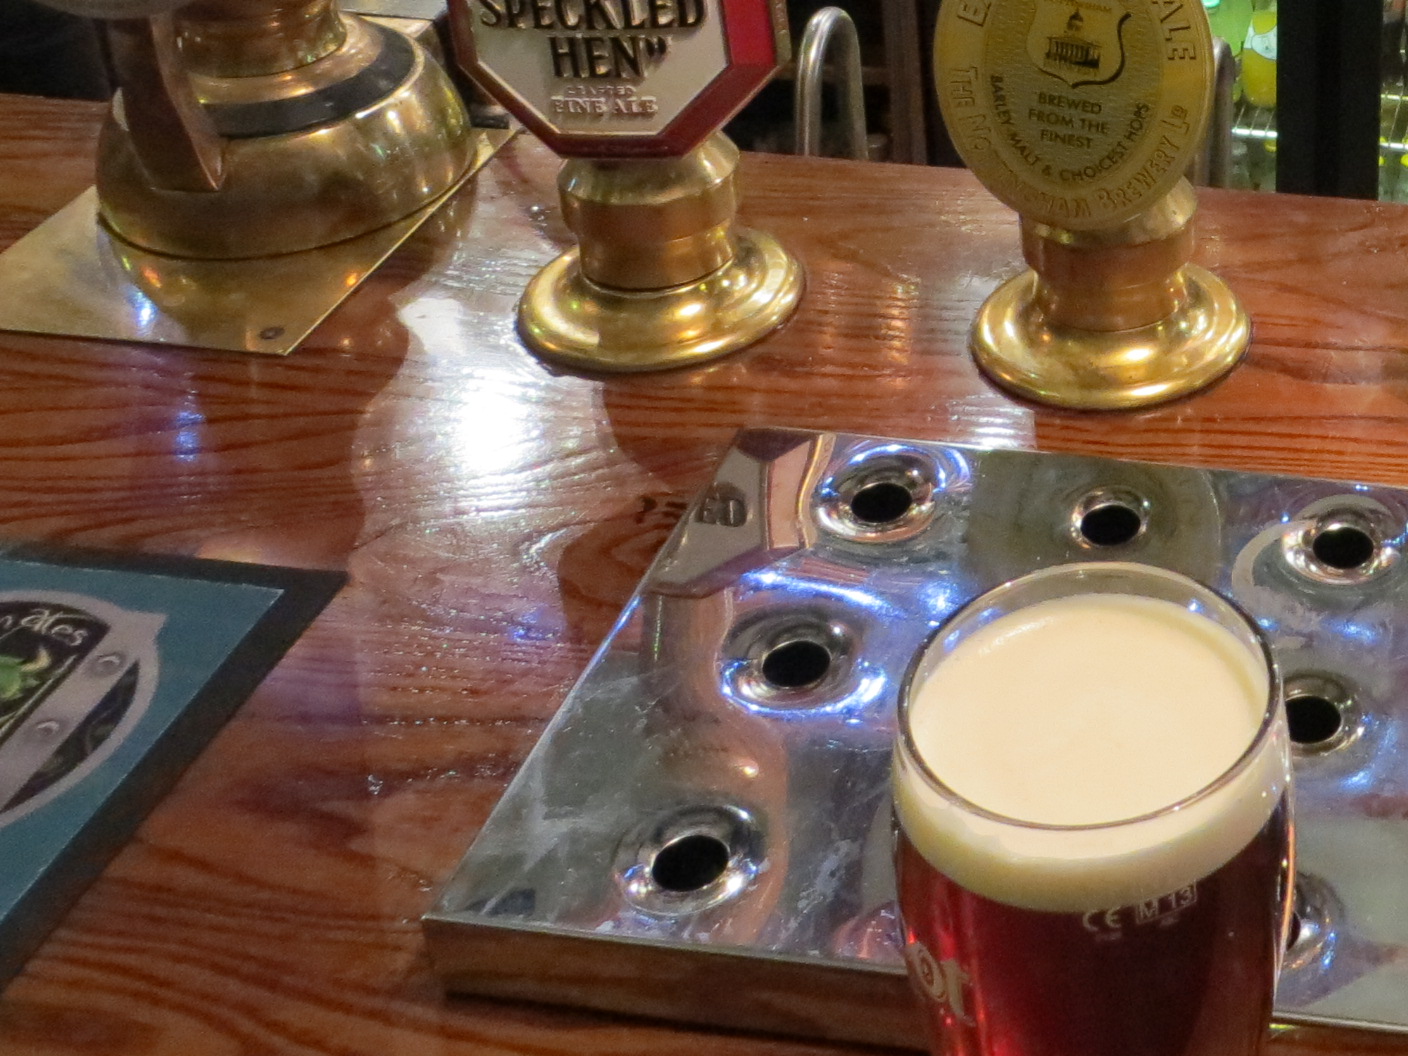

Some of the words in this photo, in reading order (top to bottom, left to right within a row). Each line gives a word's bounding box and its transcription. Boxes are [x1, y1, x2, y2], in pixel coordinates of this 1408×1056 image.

[612, 97, 659, 115] ALE
[1037, 93, 1103, 115] BREWED
[1028, 108, 1075, 129] FROM
[1079, 117, 1110, 136] THE
[1009, 133, 1043, 169] MALT
[1059, 141, 1130, 183] CHOICEST
[1125, 102, 1151, 141] HOPS
[1040, 127, 1094, 150] FINEST
